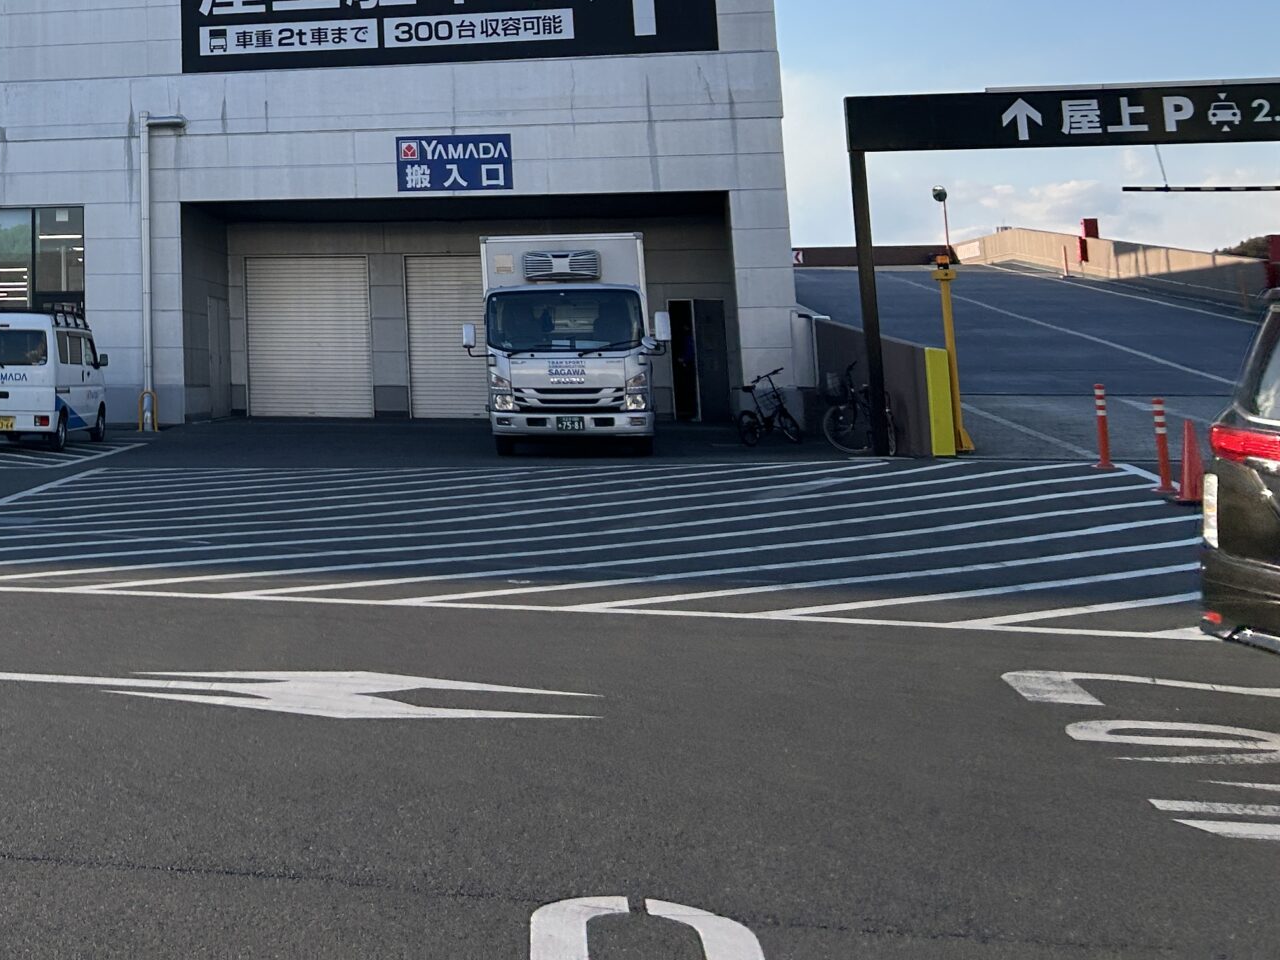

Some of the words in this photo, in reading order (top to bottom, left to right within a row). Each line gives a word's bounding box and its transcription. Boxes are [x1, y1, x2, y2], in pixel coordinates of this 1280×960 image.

[394, 14, 563, 42] 300台収容可能
[420, 139, 509, 161] YAMADA
[405, 163, 506, 189] 搬入口
